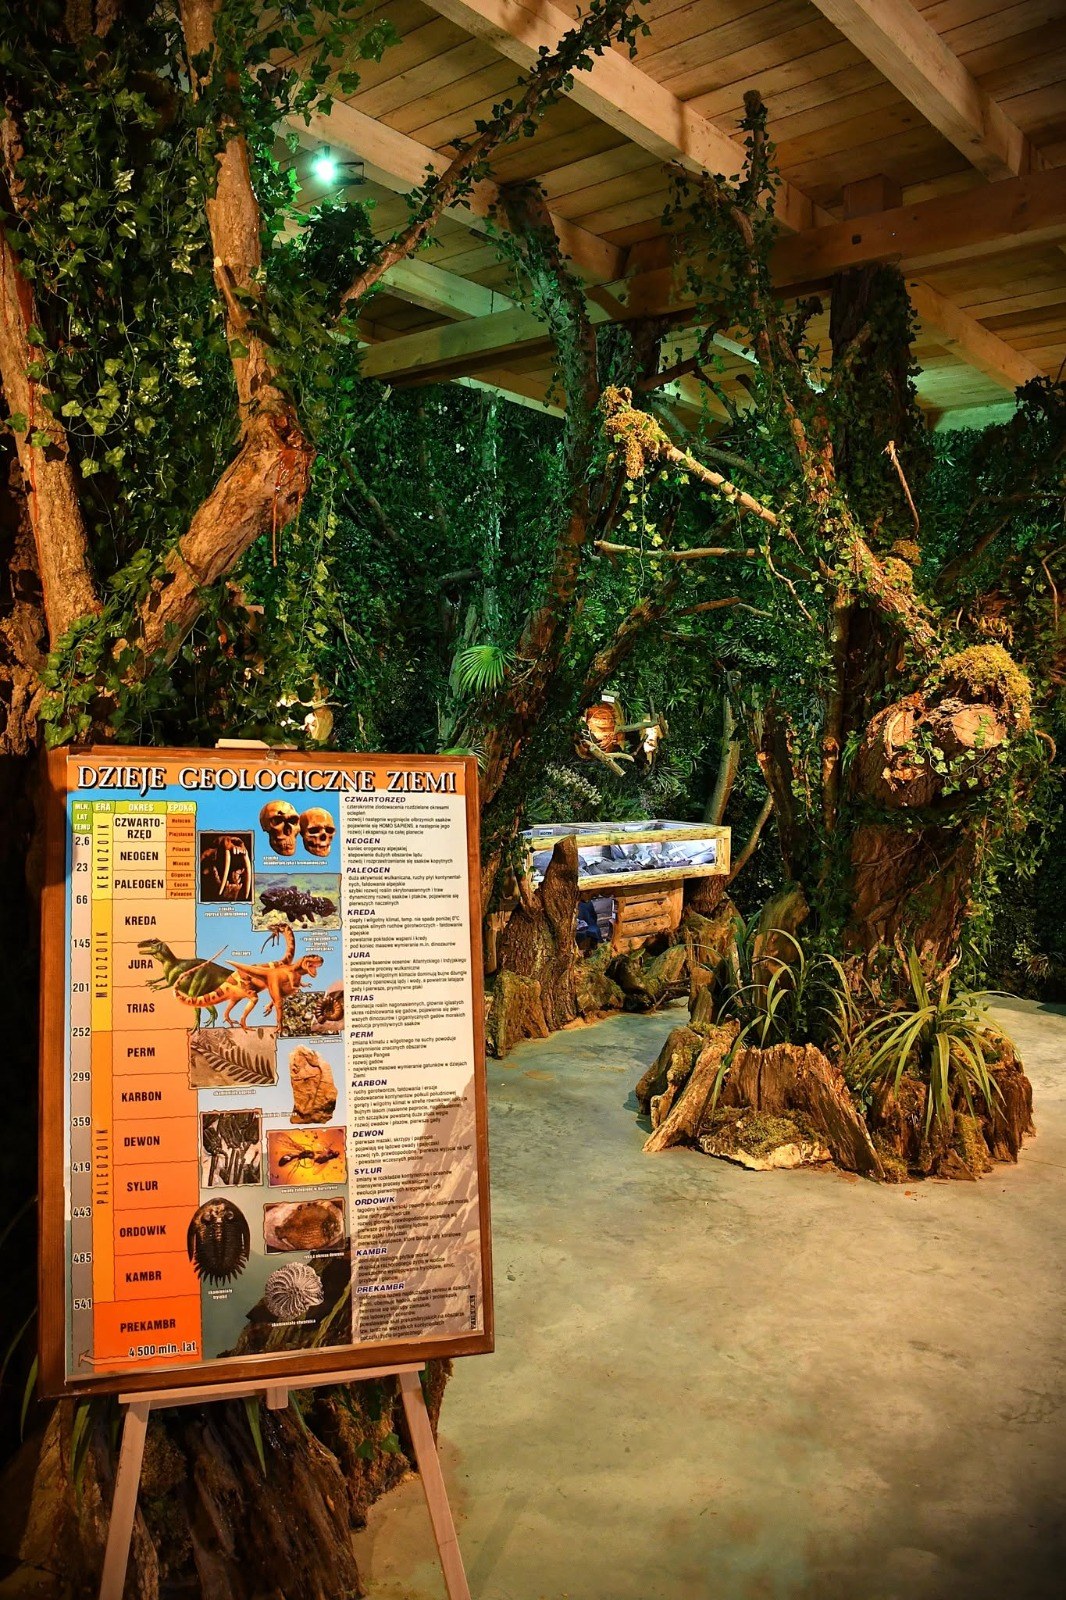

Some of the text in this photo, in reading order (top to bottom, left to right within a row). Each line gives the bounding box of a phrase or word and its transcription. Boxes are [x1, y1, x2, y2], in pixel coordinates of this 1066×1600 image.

[77, 766, 457, 796] DZIEJE GEOLOGICZNE ZIEMI
[95, 803, 110, 811] ERA
[128, 803, 154, 812] OKRES
[168, 804, 195, 812] EPOKA
[115, 818, 164, 828] CZWARTO-
[128, 830, 151, 840] RZĘD
[75, 837, 90, 846] 2,6
[97, 824, 110, 888] KENOZOIK
[120, 851, 158, 860] NEOGEN
[77, 863, 88, 872] 23
[115, 879, 164, 889] PALEOGEN
[76, 896, 88, 904] 66
[125, 916, 156, 925] KREDA
[73, 939, 90, 948] 145
[96, 932, 108, 998] MEZOZOIK
[128, 960, 153, 969] JURA
[73, 983, 89, 992] 201
[127, 1004, 155, 1013] TRIAS
[73, 1028, 90, 1037] 252
[127, 1048, 155, 1057] PERM
[73, 1072, 90, 1081] 299
[351, 1079, 387, 1087] KARBON
[122, 1091, 161, 1102] KARBON
[73, 1117, 90, 1126] 359
[124, 1136, 160, 1146] DEWON
[73, 1162, 90, 1171] 419
[96, 1129, 108, 1204] PALEOZOIK
[127, 1181, 158, 1191] SYLUR
[355, 1197, 395, 1205] ORDOWIK
[73, 1207, 91, 1217] 443
[120, 1225, 166, 1237] ORDOWIK
[356, 1248, 387, 1256] KAMBR
[73, 1254, 91, 1262] 485
[126, 1271, 161, 1282] KAMBR
[357, 1283, 404, 1293] PREKAMBR
[74, 1299, 92, 1309] 541
[120, 1319, 176, 1332] PREKAMBR
[129, 1341, 196, 1356] 4 500 mln. lat
